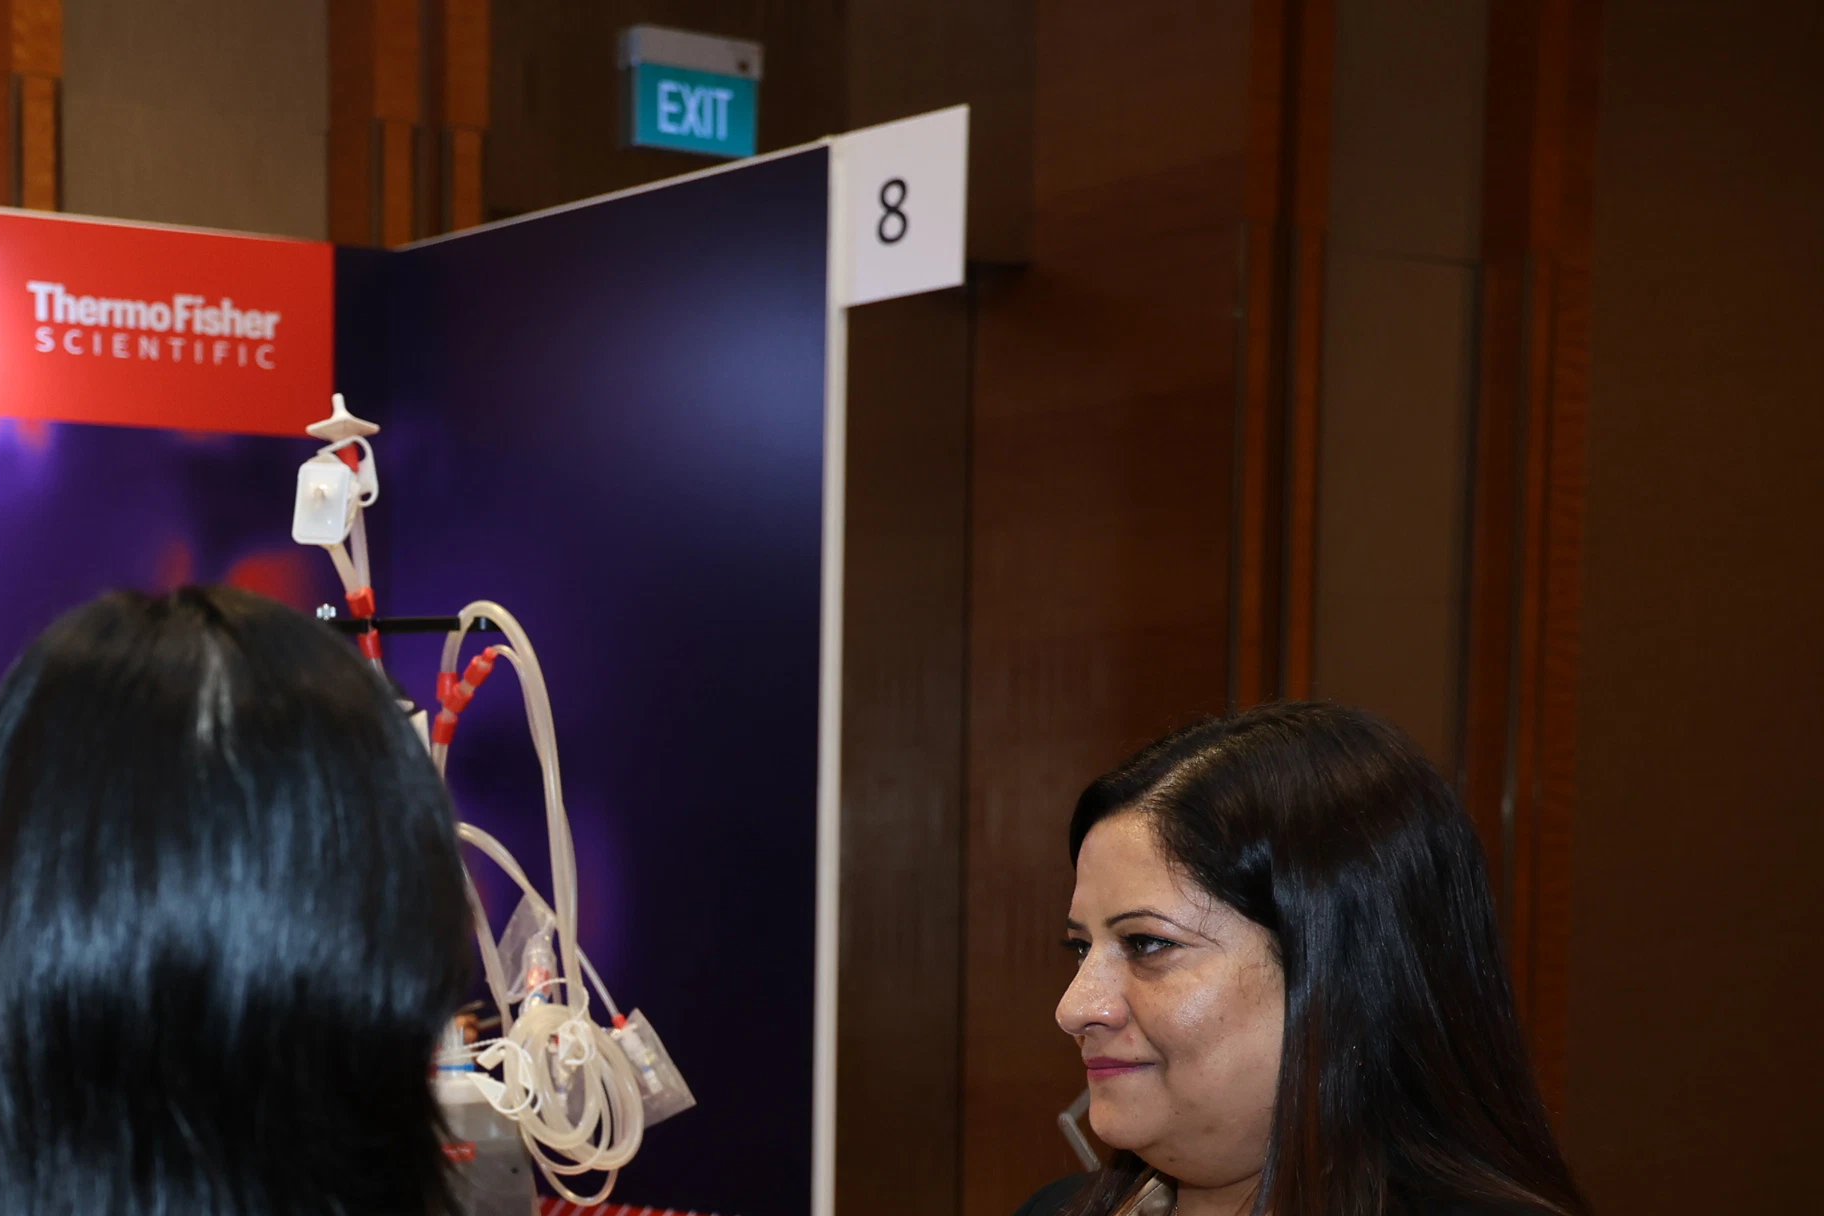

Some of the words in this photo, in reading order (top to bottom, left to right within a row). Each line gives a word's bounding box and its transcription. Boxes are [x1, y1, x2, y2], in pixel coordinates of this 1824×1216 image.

[657, 79, 734, 140] EXIT
[878, 178, 908, 244] 8
[34, 326, 276, 370] SCIENTIFIC
